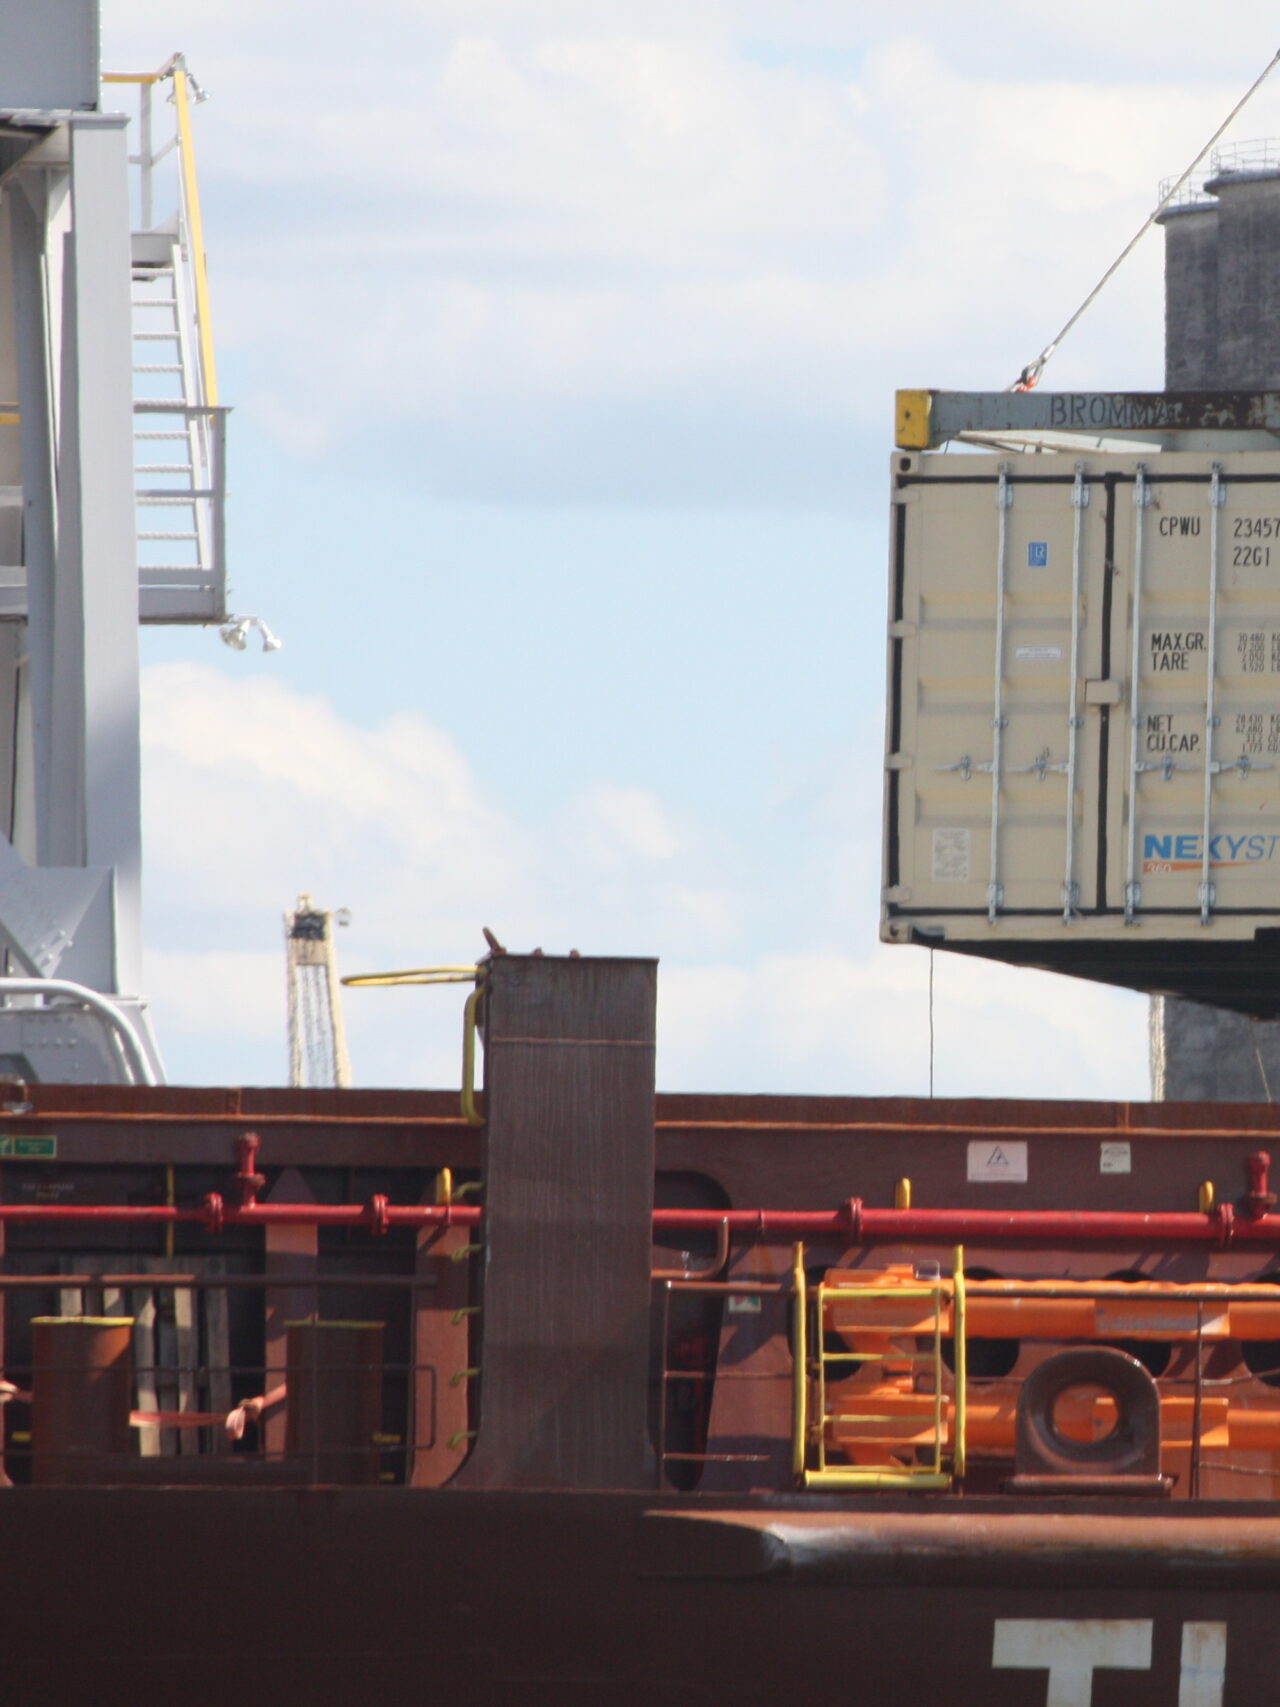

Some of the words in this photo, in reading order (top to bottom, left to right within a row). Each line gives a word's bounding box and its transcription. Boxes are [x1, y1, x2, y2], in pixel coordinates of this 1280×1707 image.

[1159, 516, 1201, 536] CPWU
[1233, 546, 1270, 567] 22G1
[1151, 632, 1207, 651] MAX.GR.
[1152, 652, 1189, 671] TARE
[1147, 714, 1173, 733] NET
